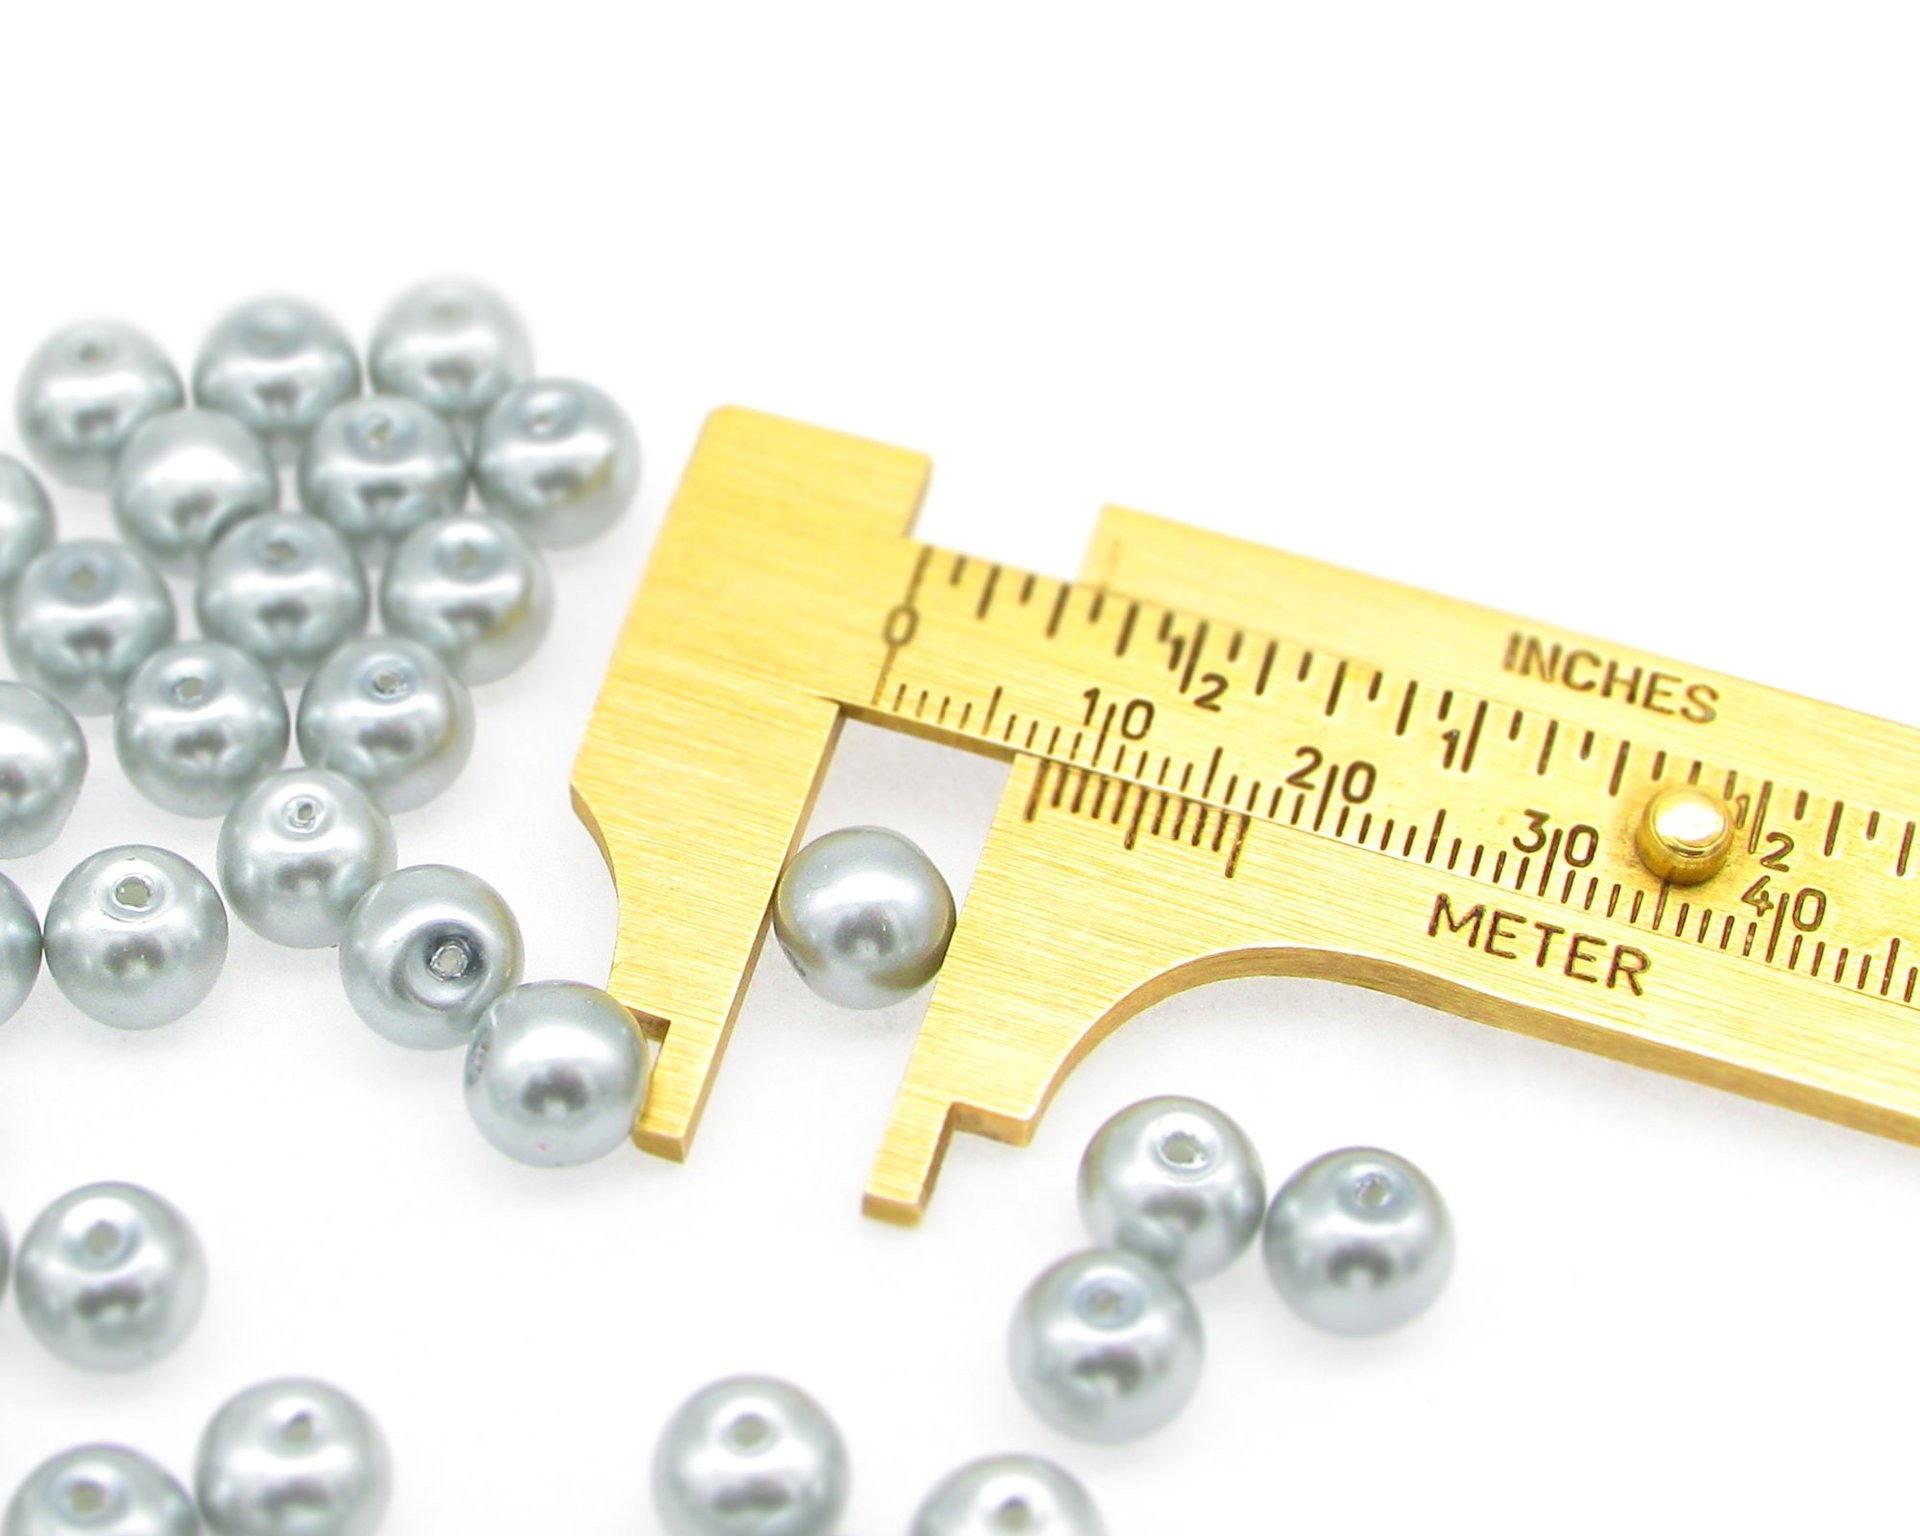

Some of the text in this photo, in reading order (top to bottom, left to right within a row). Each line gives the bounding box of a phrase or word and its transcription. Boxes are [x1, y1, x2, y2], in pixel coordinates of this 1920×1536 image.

[882, 603, 919, 648] 0
[1502, 631, 1720, 724] INCHES
[1286, 746, 1377, 804] 20
[1512, 809, 1600, 868] 30
[1741, 875, 1828, 932] 40
[1427, 892, 1651, 997] METER
